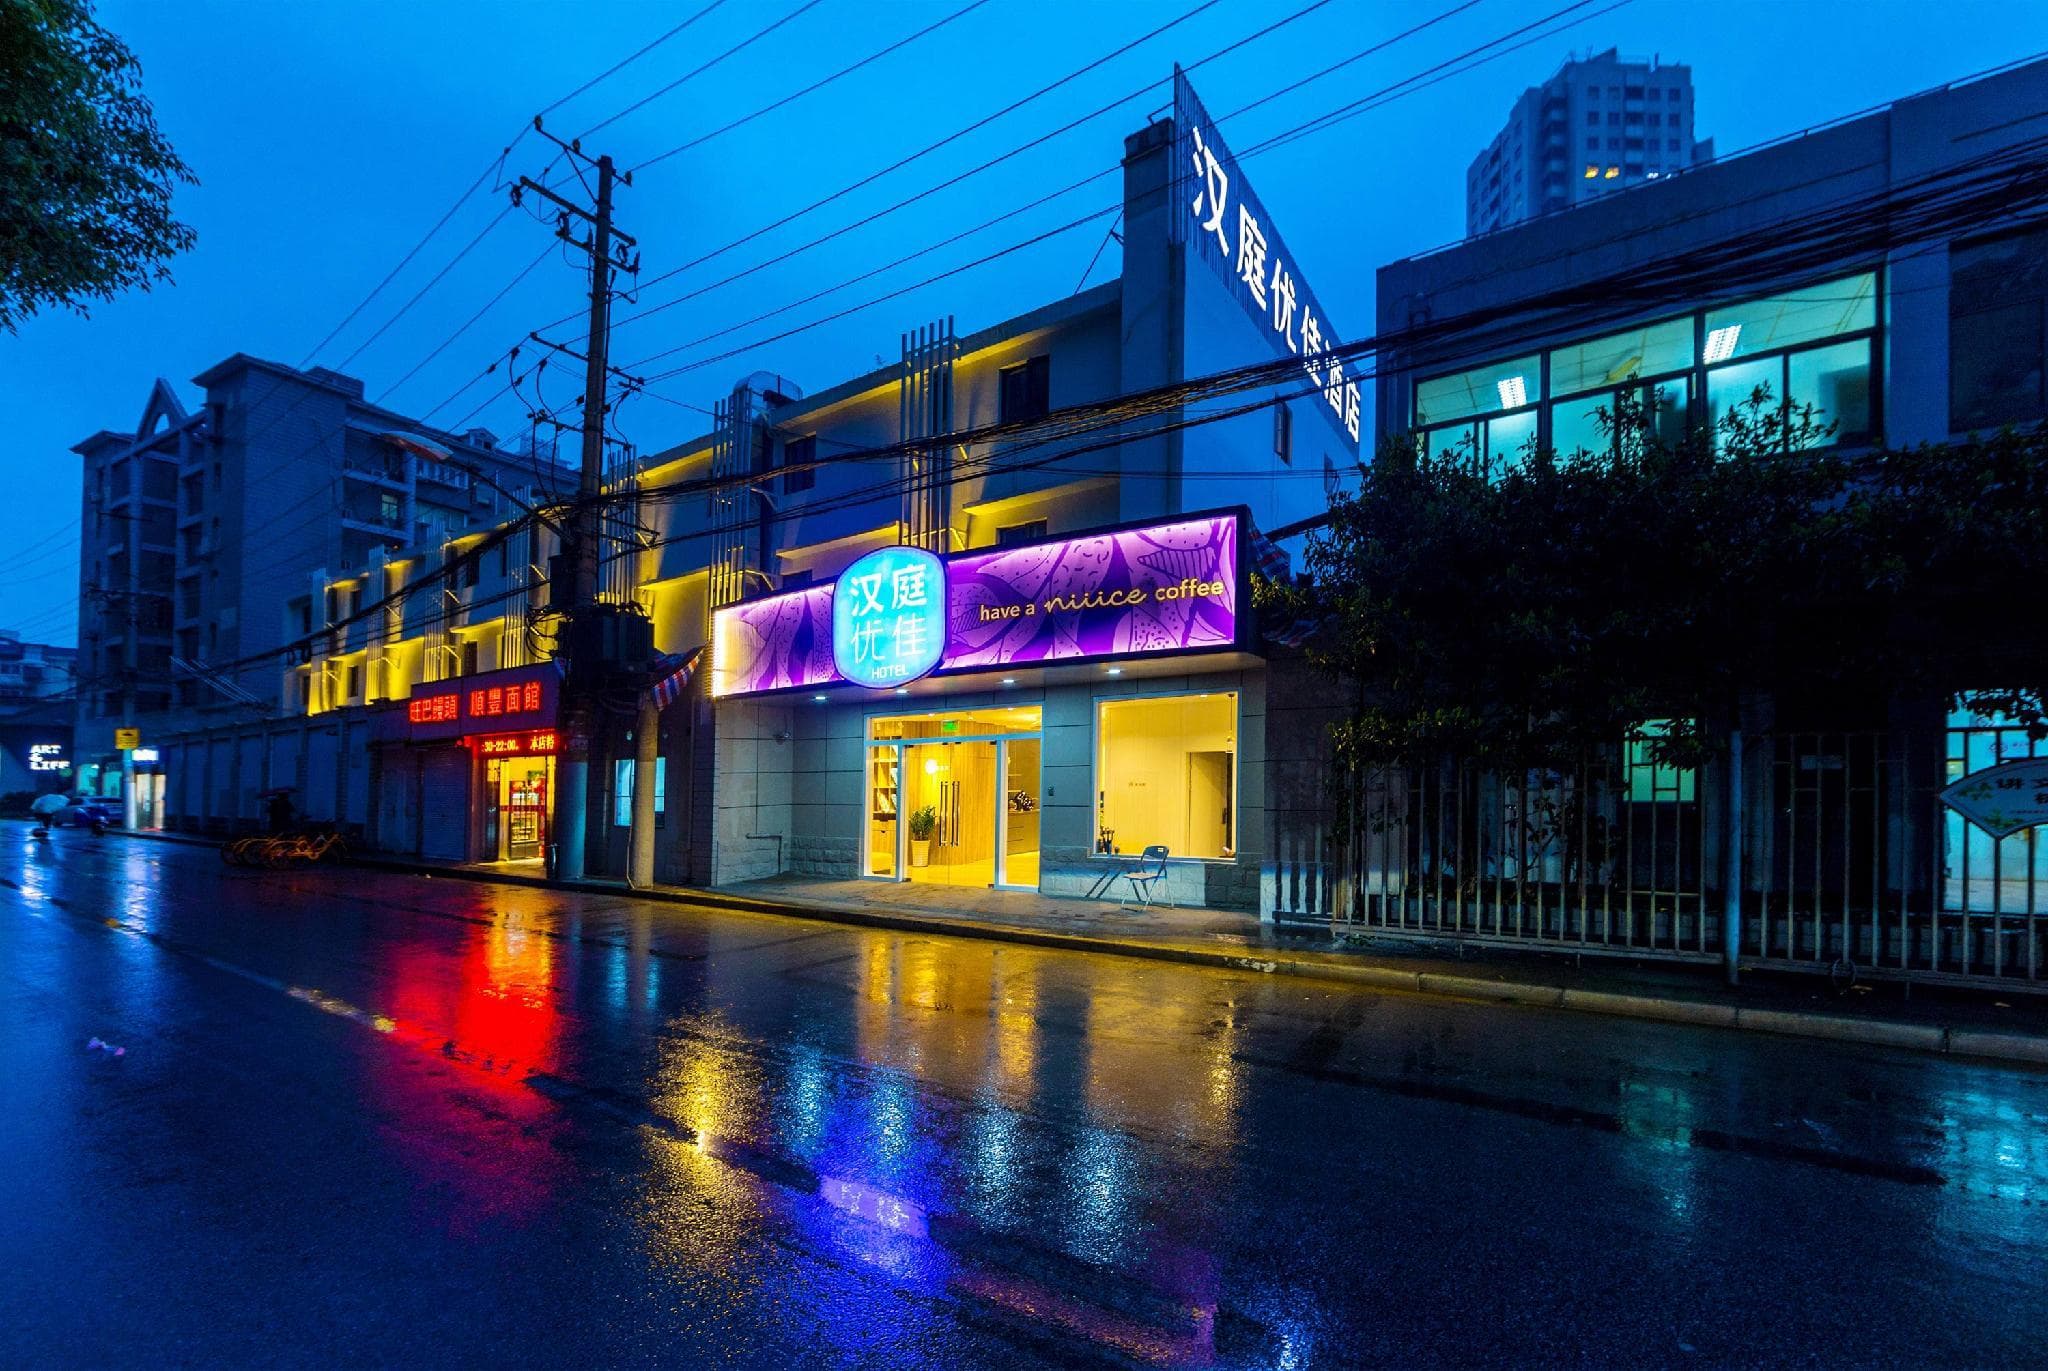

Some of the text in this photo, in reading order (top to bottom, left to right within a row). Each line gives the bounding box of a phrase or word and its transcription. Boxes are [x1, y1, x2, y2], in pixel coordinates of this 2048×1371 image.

[1193, 126, 1360, 443] 汉庭优佳酒店
[849, 564, 928, 617] 汉庭
[979, 579, 1224, 621] have a niiice coffee
[850, 612, 928, 665] 优佳
[871, 664, 910, 680] HOTEL
